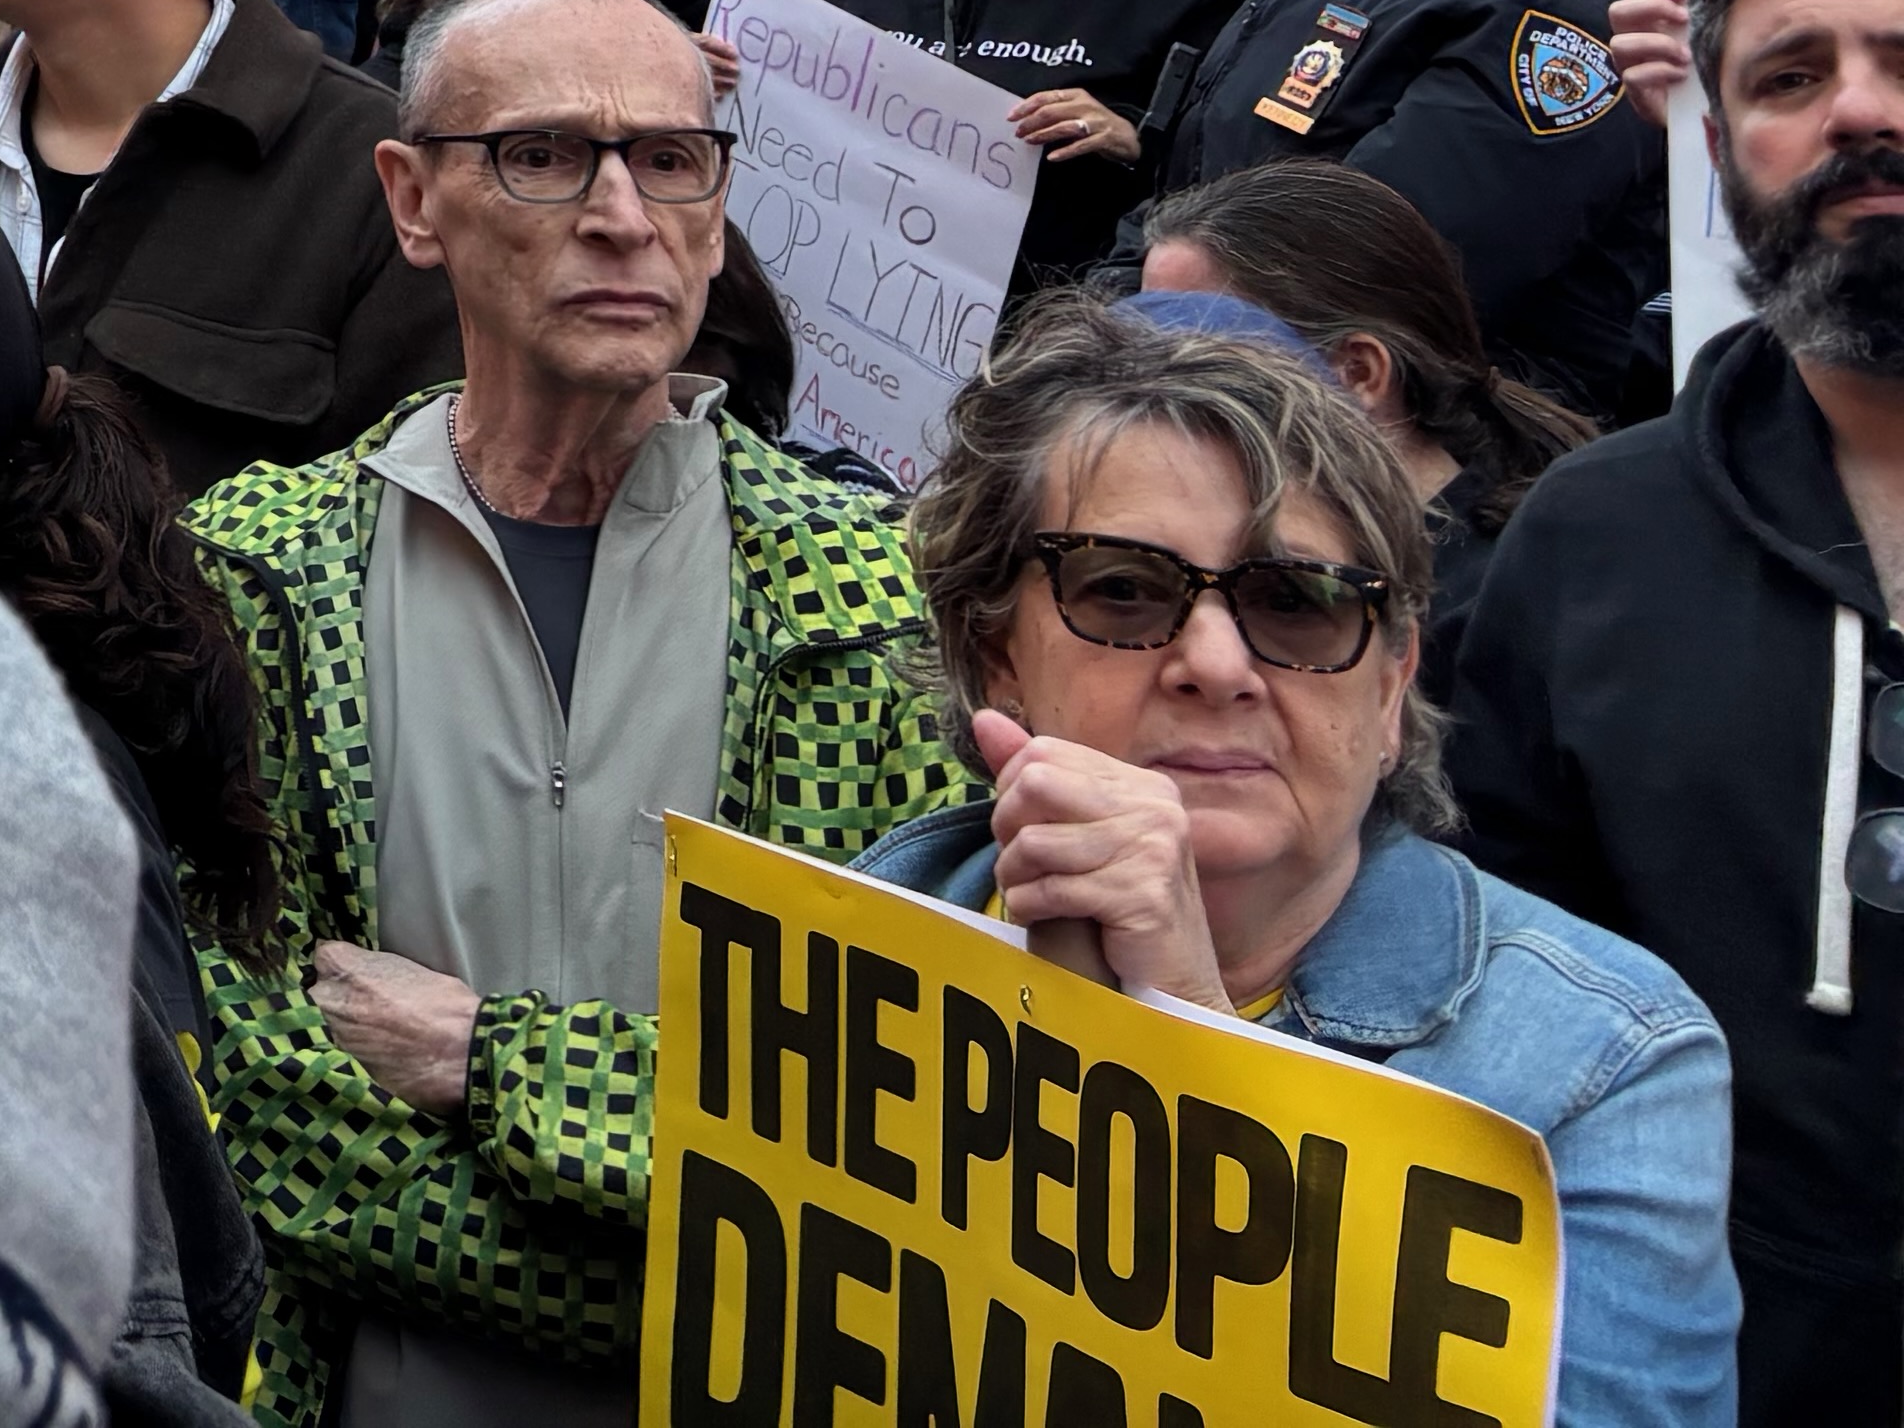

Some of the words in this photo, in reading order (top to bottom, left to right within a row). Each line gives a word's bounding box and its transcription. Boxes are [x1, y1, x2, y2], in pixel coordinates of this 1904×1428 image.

[977, 36, 1094, 68] enough.
[1517, 52, 1531, 84] CITY
[1529, 30, 1620, 85] DEPARTMENT
[1556, 25, 1607, 62] POLICE
[727, 93, 843, 204] Need
[874, 162, 936, 246] To
[729, 159, 821, 280] OP
[826, 231, 1000, 374] LYING
[780, 294, 901, 400] Because
[795, 372, 918, 486] America
[679, 880, 921, 1206] THE
[940, 982, 1525, 1428] PEOPLE
[669, 1149, 1209, 1428] DEM
